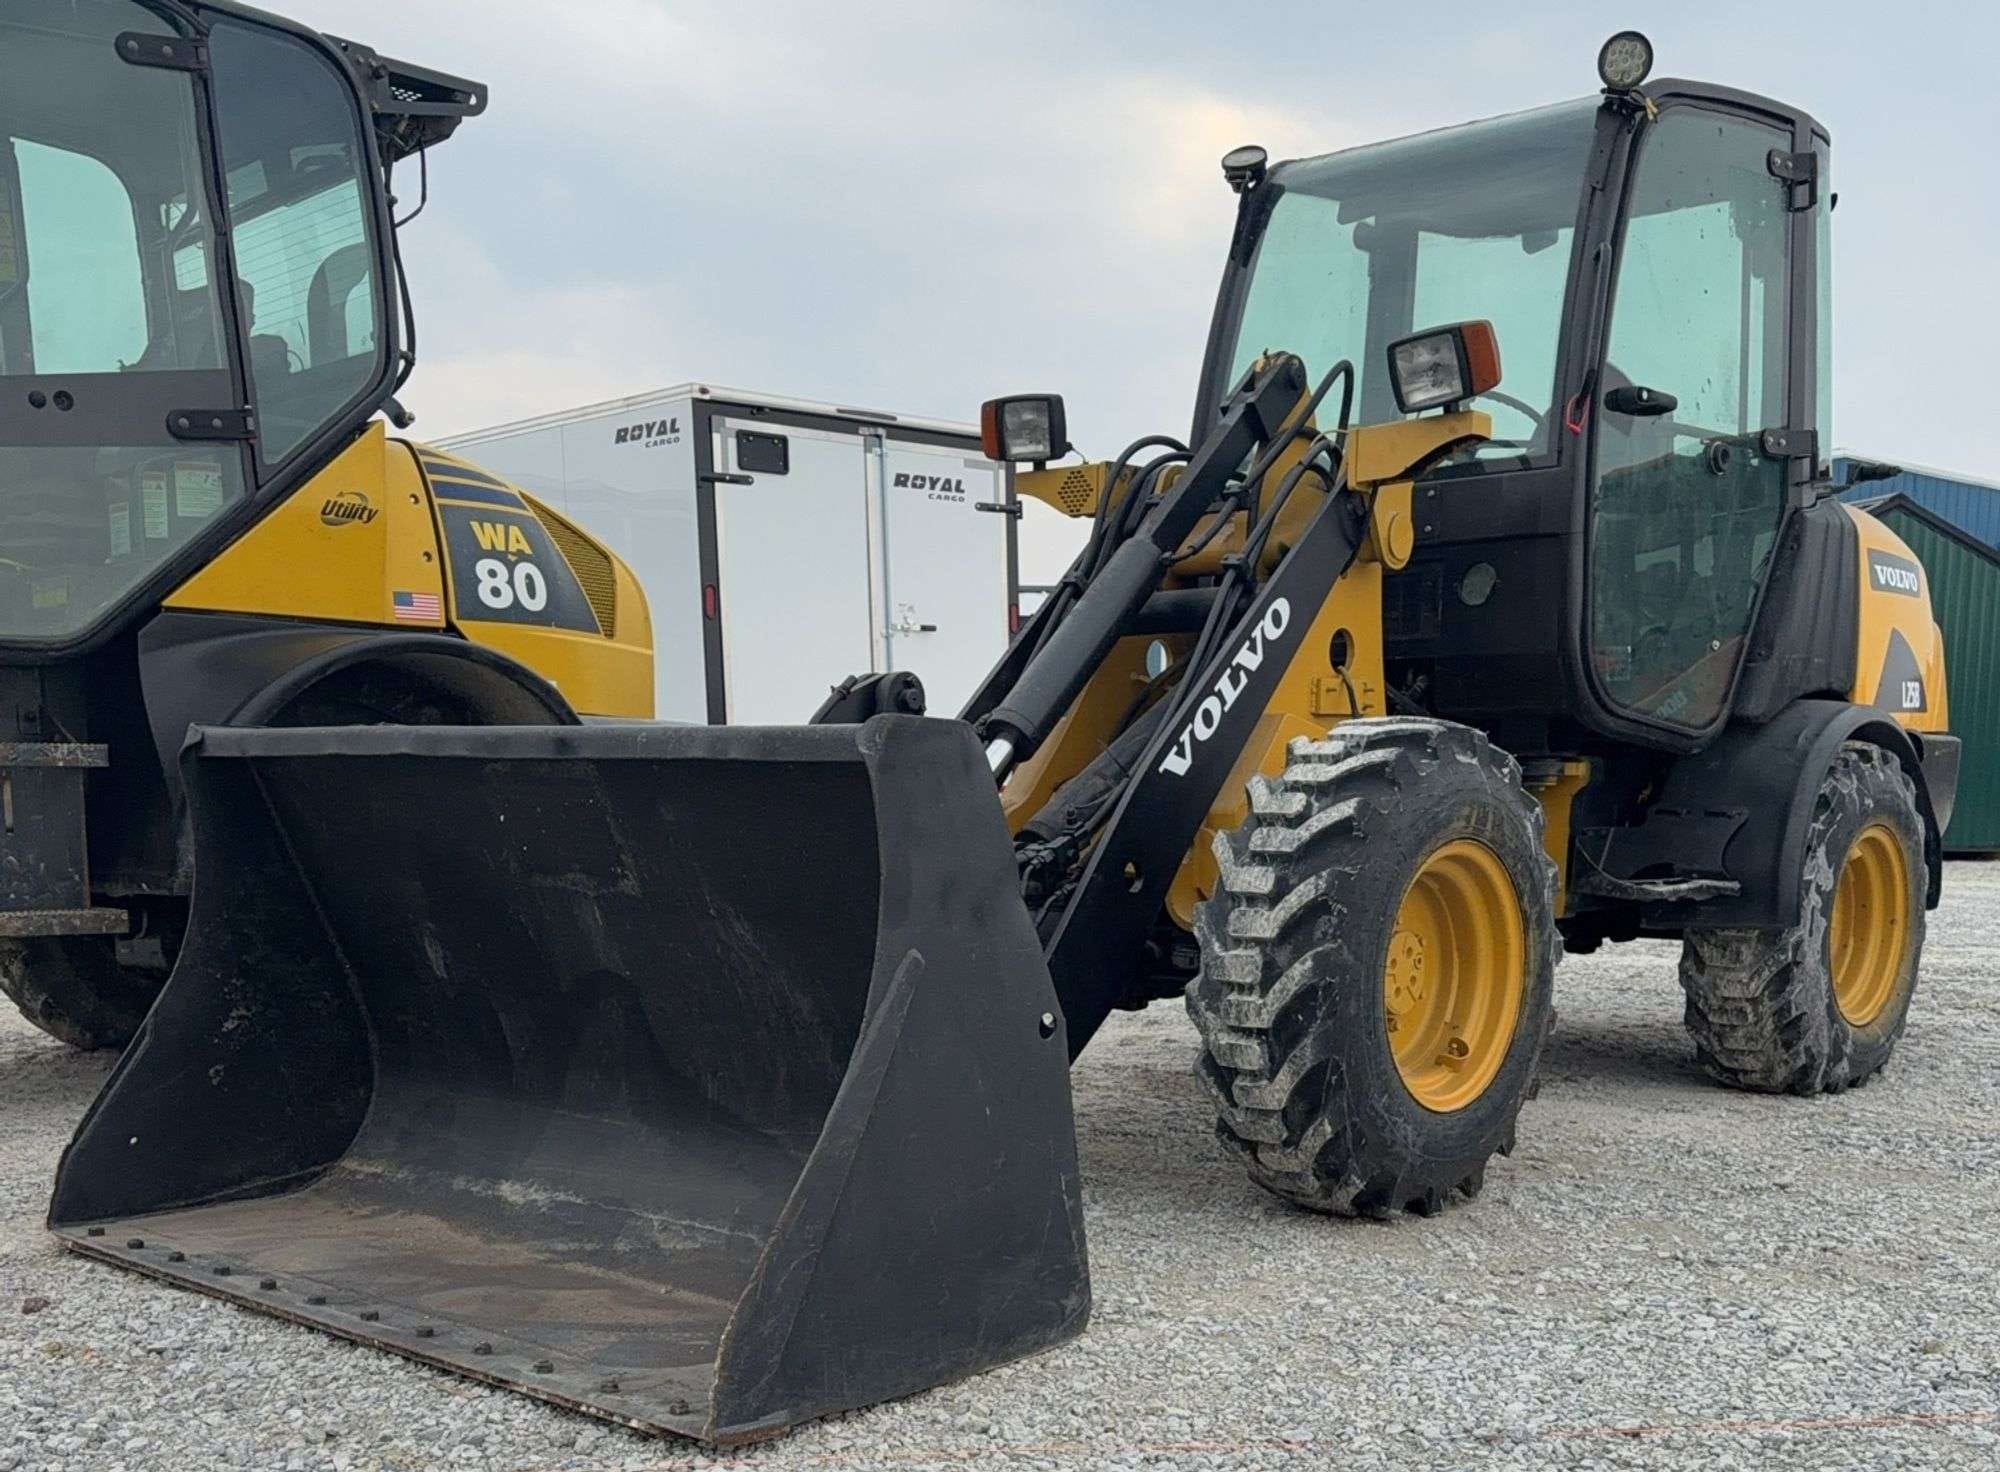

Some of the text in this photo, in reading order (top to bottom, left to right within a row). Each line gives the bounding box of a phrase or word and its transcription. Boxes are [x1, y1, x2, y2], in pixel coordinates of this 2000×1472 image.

[615, 417, 680, 444] ROYAL
[645, 436, 680, 448] CARGO
[894, 473, 965, 493] ROYAL
[320, 499, 379, 523] Utility
[928, 493, 965, 502] CARGO
[469, 521, 533, 554] WA
[475, 558, 547, 611] 80
[1873, 564, 1918, 592] VOLVO
[1158, 597, 1291, 777] VOLVO
